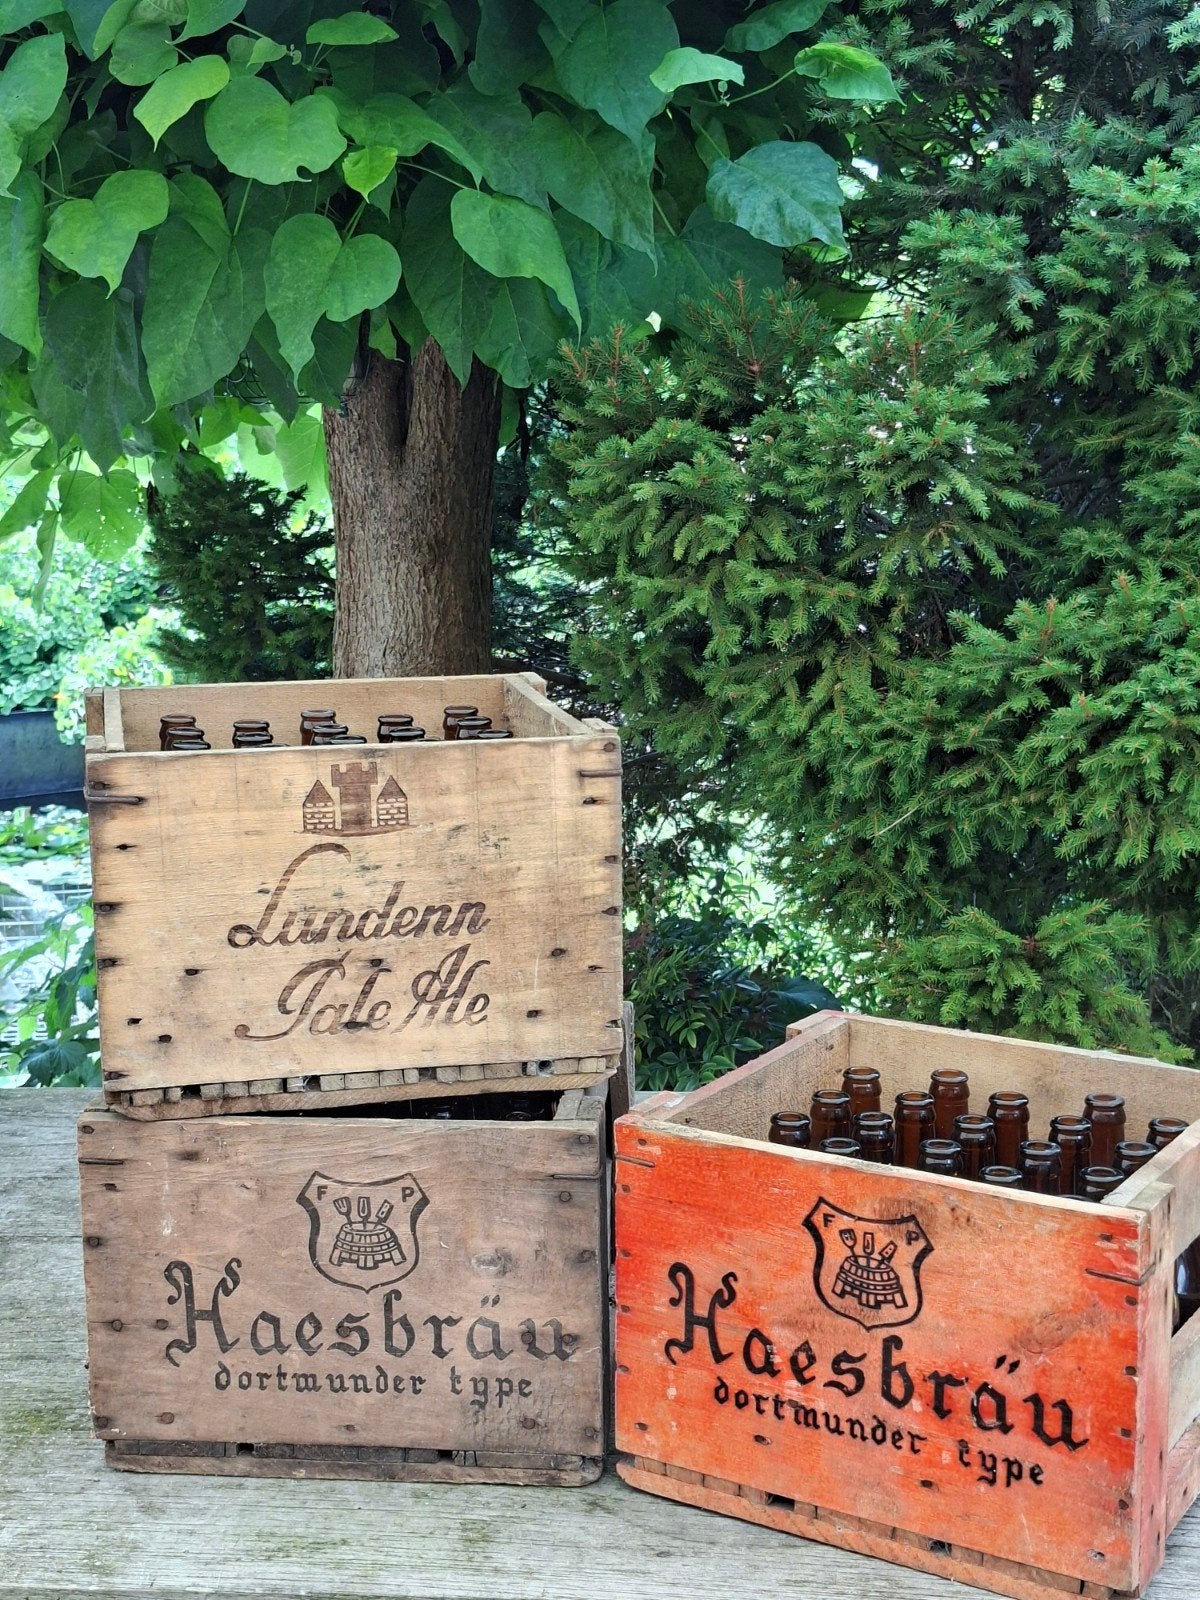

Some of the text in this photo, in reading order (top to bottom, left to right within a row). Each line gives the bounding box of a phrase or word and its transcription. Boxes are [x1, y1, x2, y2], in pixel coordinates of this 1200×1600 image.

[227, 842, 491, 949] Lundenn
[234, 943, 491, 1042] Pale Ale
[316, 1185, 415, 1202] F P
[822, 1213, 919, 1246] F P
[163, 1257, 578, 1367] Haesbräu
[665, 1261, 1090, 1452] Haesbräu
[214, 1361, 533, 1408] dortmunder type
[714, 1376, 1045, 1488] dortmunder type
